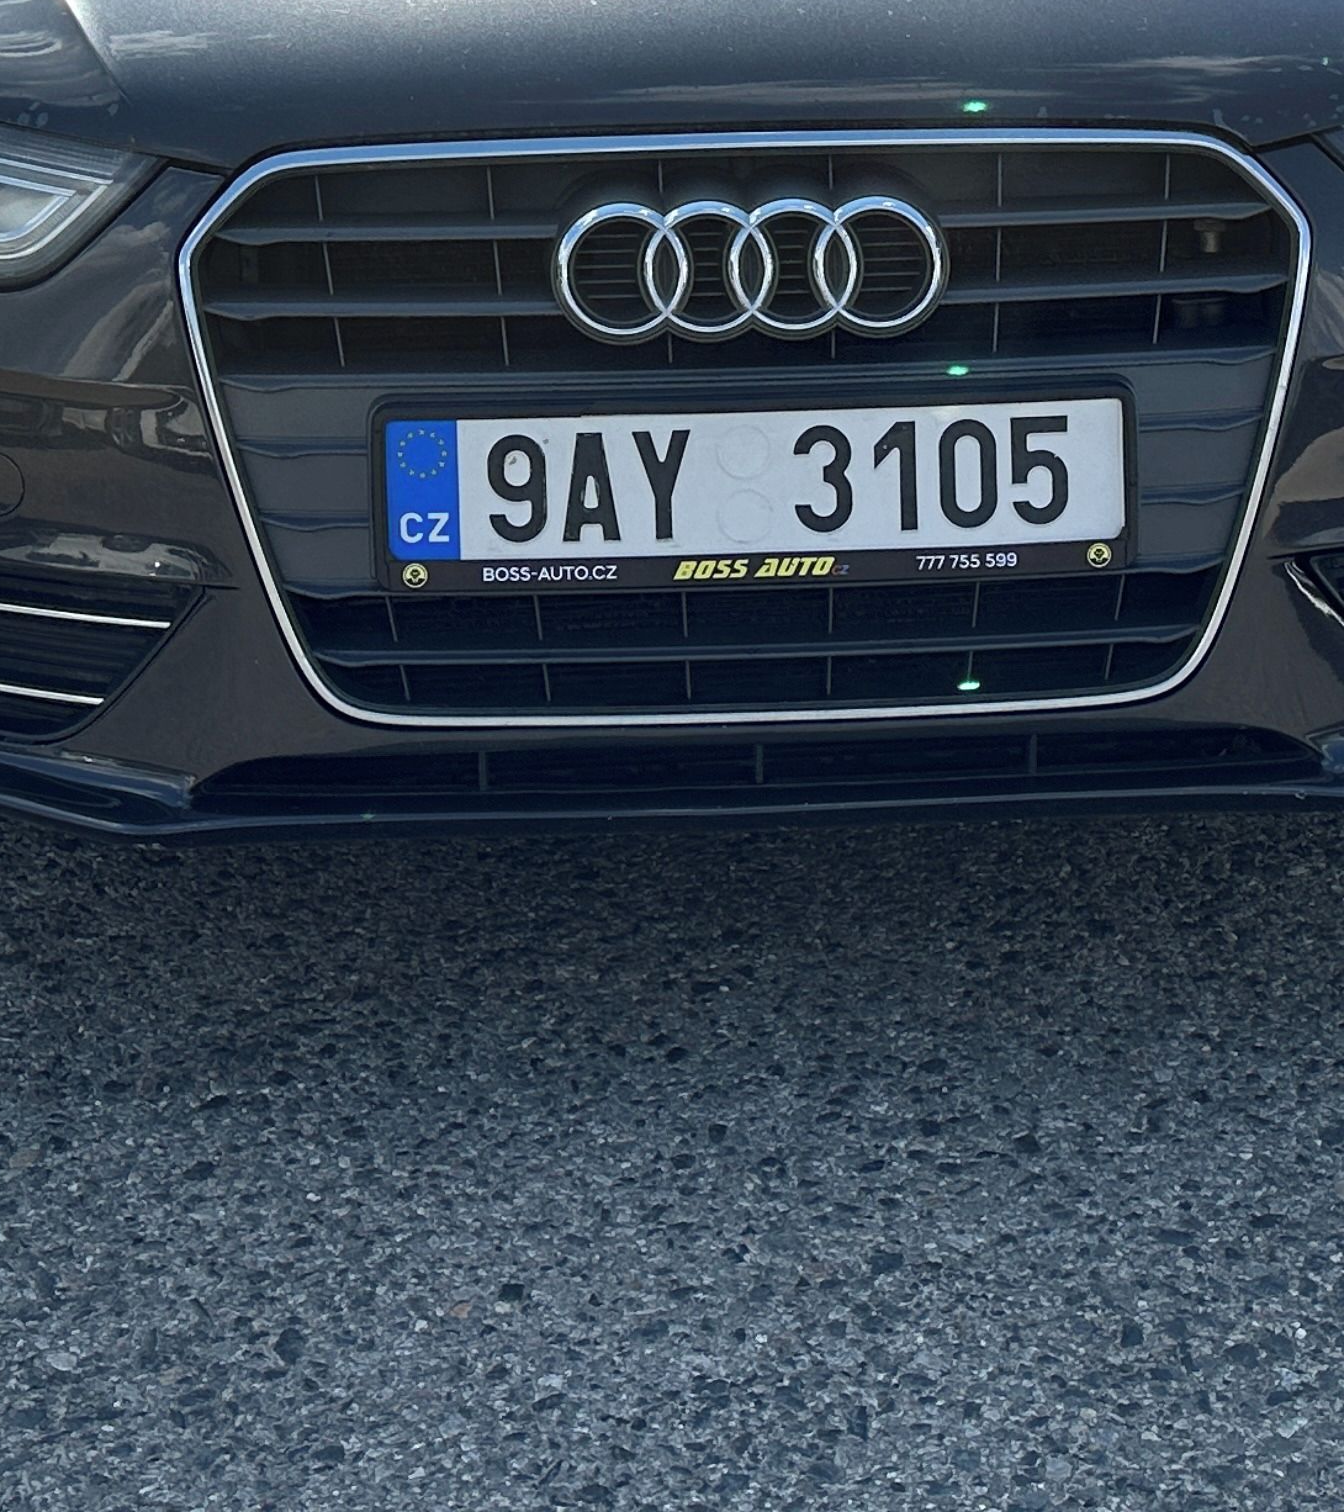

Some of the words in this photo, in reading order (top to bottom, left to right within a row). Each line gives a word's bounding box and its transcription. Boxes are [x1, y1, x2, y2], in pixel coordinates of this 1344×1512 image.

[487, 429, 690, 543] 9AY
[793, 415, 1069, 533] 3105
[400, 512, 450, 543] CZ
[482, 565, 618, 582] BOSS-AUTO.CZ
[673, 559, 749, 580] BOSS
[754, 556, 835, 578] AUTO
[916, 555, 945, 571] 777
[950, 554, 980, 570] 755
[985, 552, 1017, 568] 599
